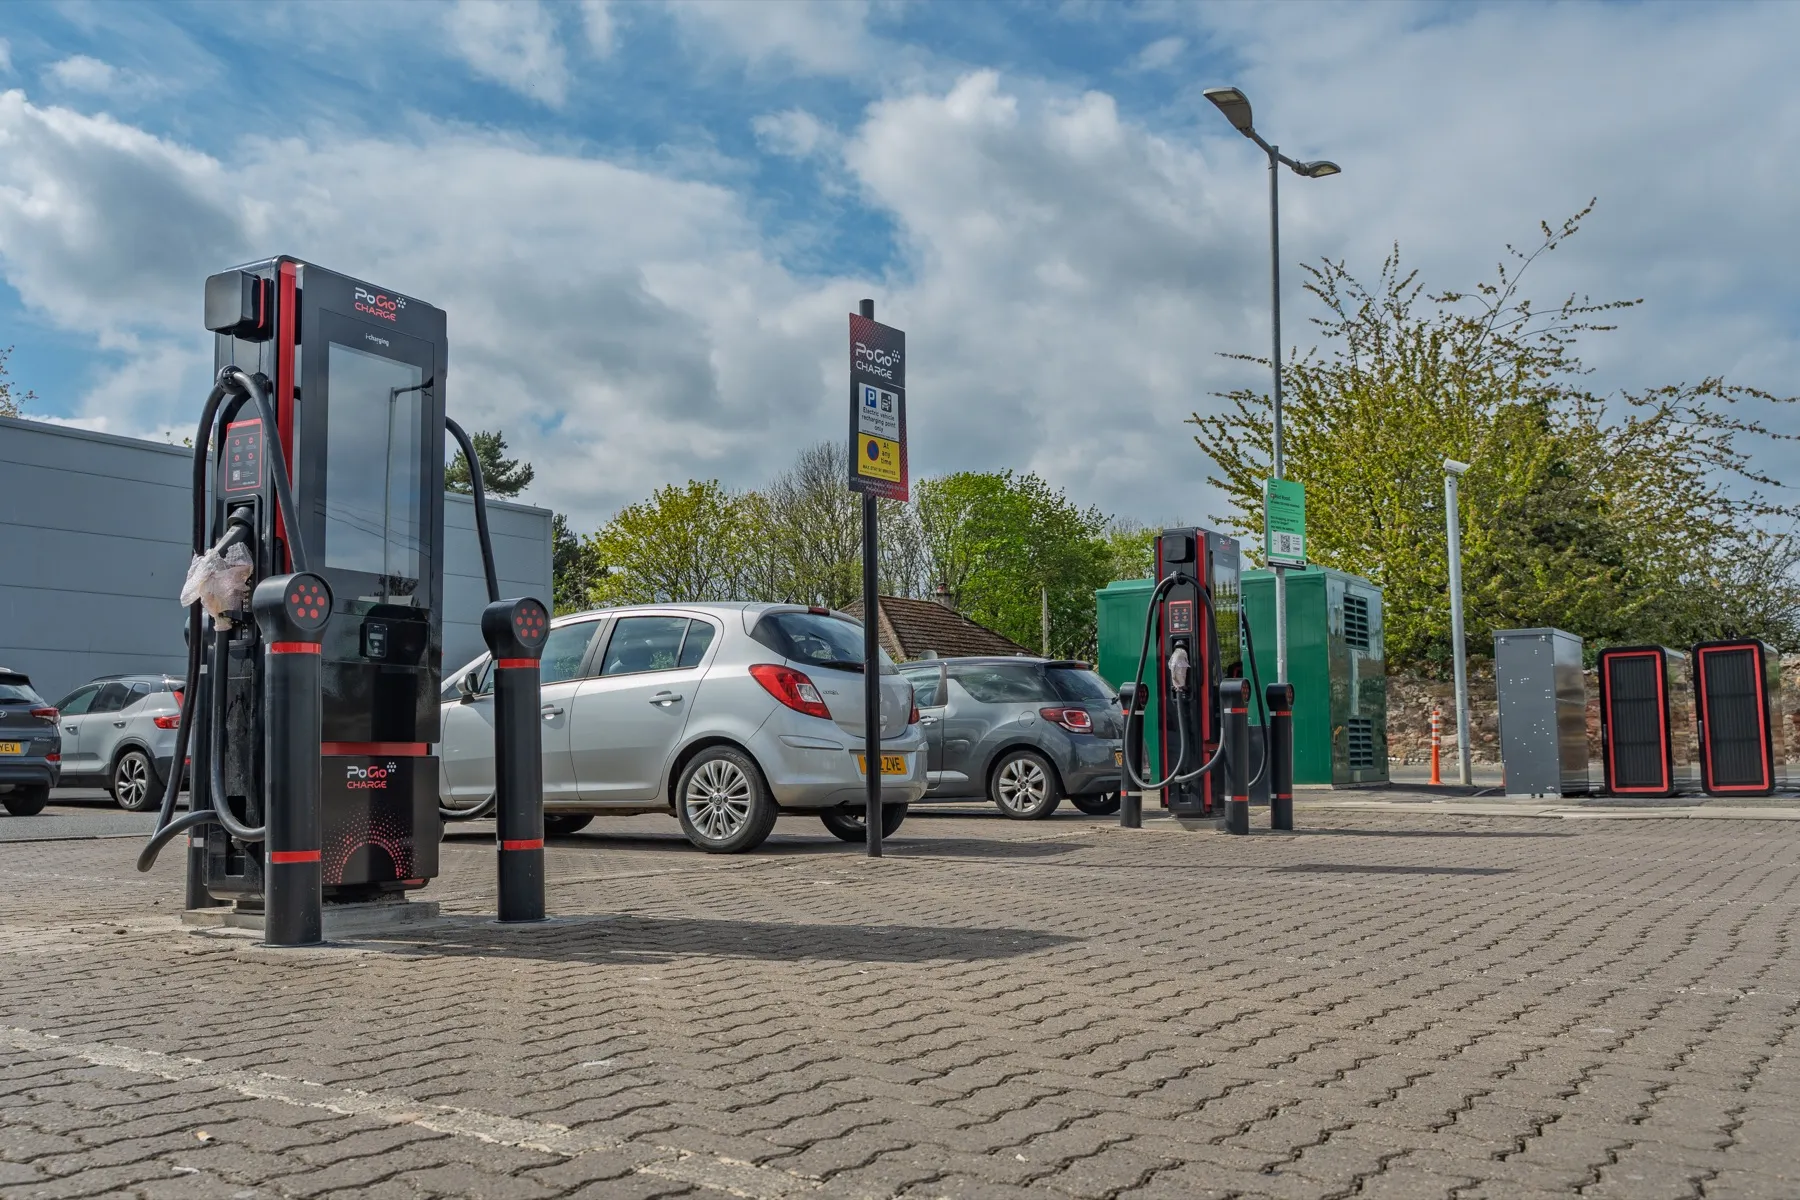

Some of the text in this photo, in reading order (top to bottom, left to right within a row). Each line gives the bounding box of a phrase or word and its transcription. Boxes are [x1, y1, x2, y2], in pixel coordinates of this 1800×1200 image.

[355, 287, 396, 311] PoGo
[355, 302, 396, 322] CHARGE
[856, 341, 892, 366] PoGo
[856, 361, 892, 379] CHARGE
[868, 390, 875, 405] P
[863, 406, 895, 421] Electric vehicle
[874, 425, 884, 434] only
[881, 451, 891, 459] any
[881, 458, 892, 466] time
[0, 743, 15, 752] YEV
[884, 756, 902, 771] ZVE
[347, 765, 388, 779] PoGo
[347, 781, 388, 789] CHARGE
